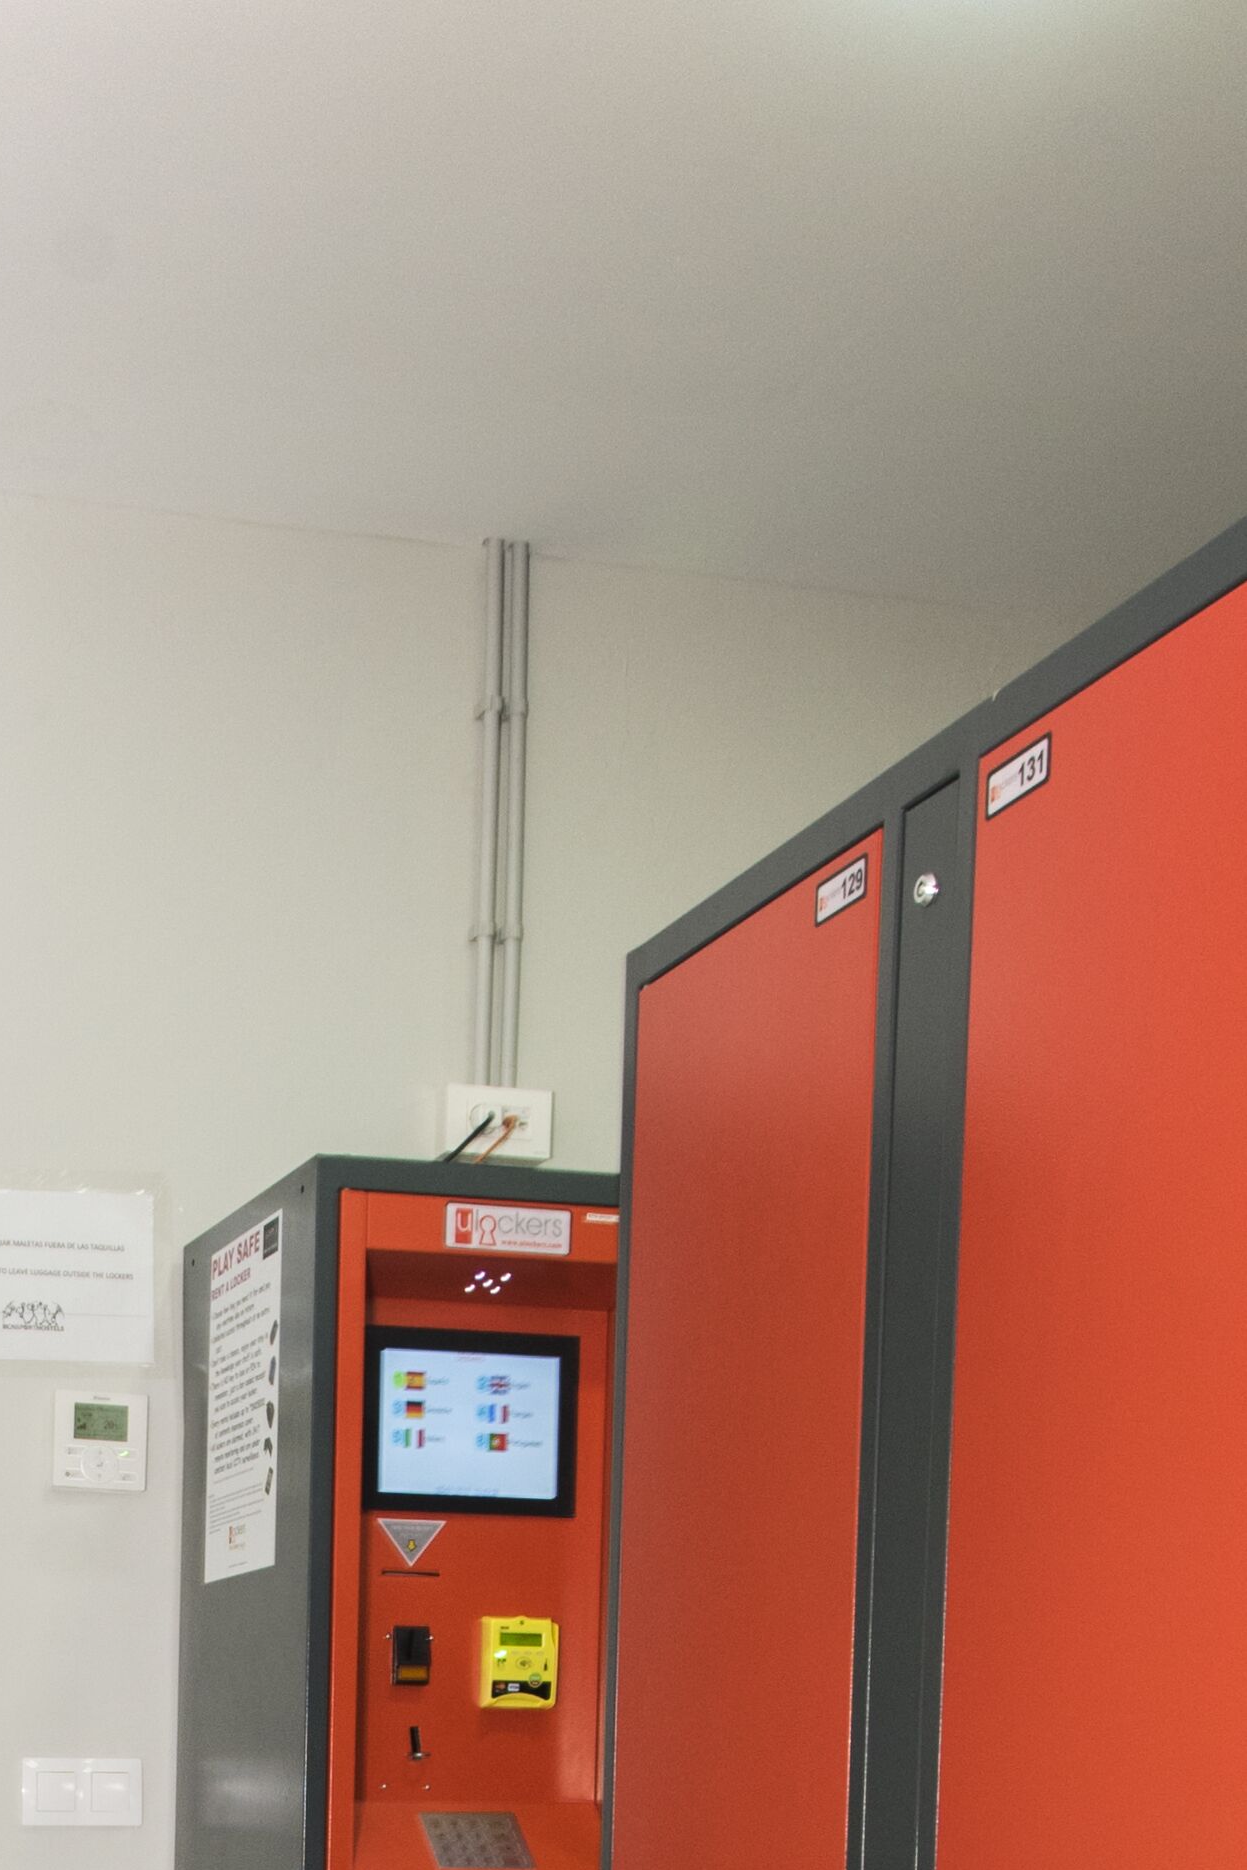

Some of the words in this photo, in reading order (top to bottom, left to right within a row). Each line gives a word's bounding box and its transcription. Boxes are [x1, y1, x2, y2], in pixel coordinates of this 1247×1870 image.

[1018, 749, 1045, 787] 131
[841, 868, 864, 900] 129
[44, 1241, 66, 1249] FUERA
[66, 1242, 76, 1250] DE
[76, 1243, 90, 1251] LAS
[212, 1248, 234, 1280] PLAY
[237, 1230, 260, 1264] SAFE
[8, 1268, 29, 1276] LEAVE
[29, 1268, 61, 1278] LUGGAGE
[62, 1271, 92, 1279] OUTSIDE
[105, 1272, 134, 1281] LOCKERS
[210, 1284, 225, 1301] RENT
[230, 1267, 251, 1290] LOCKER
